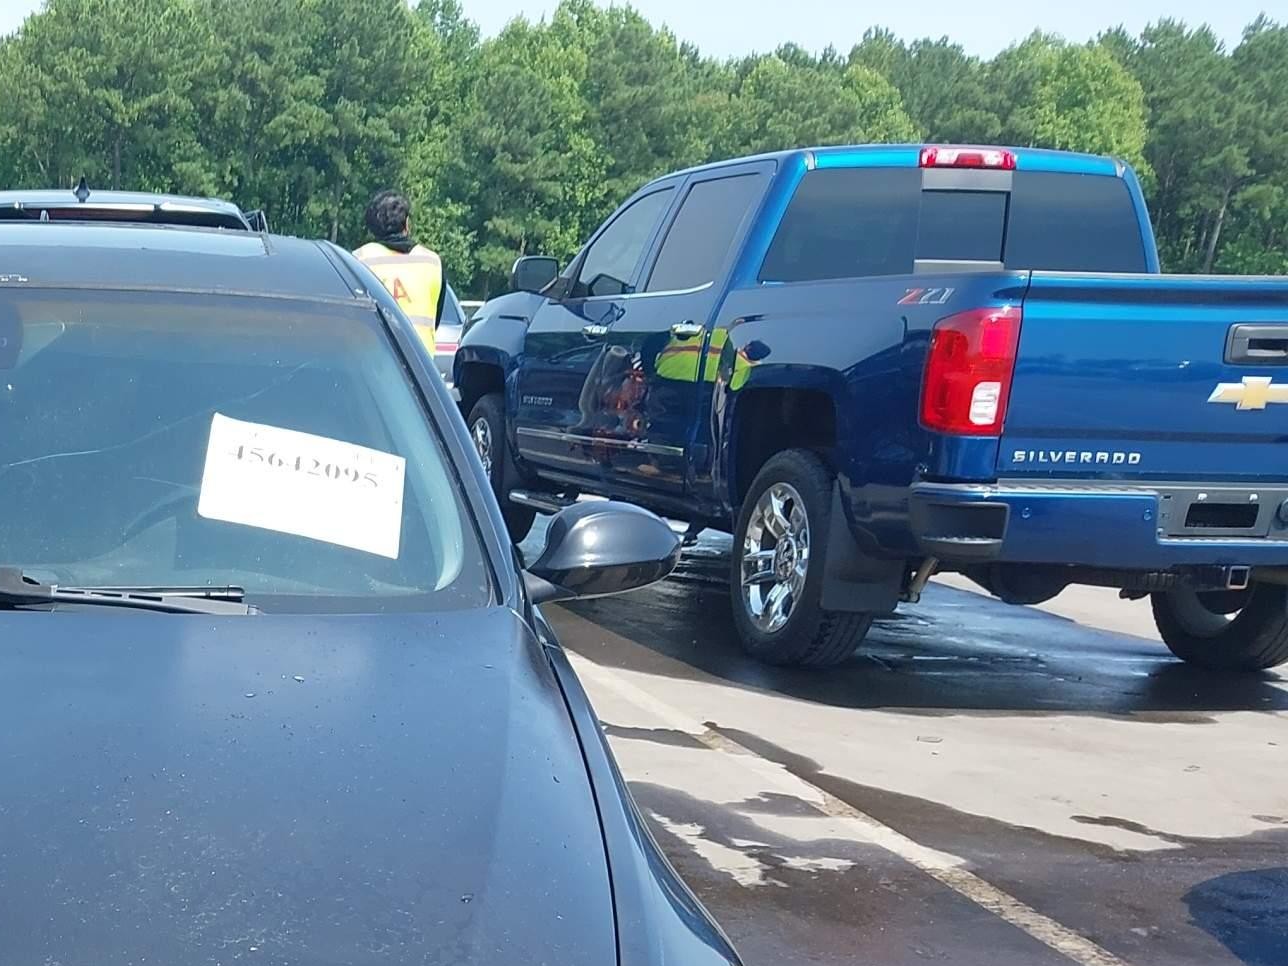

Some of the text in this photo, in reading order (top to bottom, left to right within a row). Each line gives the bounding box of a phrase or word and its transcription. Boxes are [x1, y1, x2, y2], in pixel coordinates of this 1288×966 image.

[390, 277, 413, 303] A
[896, 287, 956, 305] Z71
[226, 443, 384, 489] 45642095
[1012, 450, 1142, 465] SILVERADO
